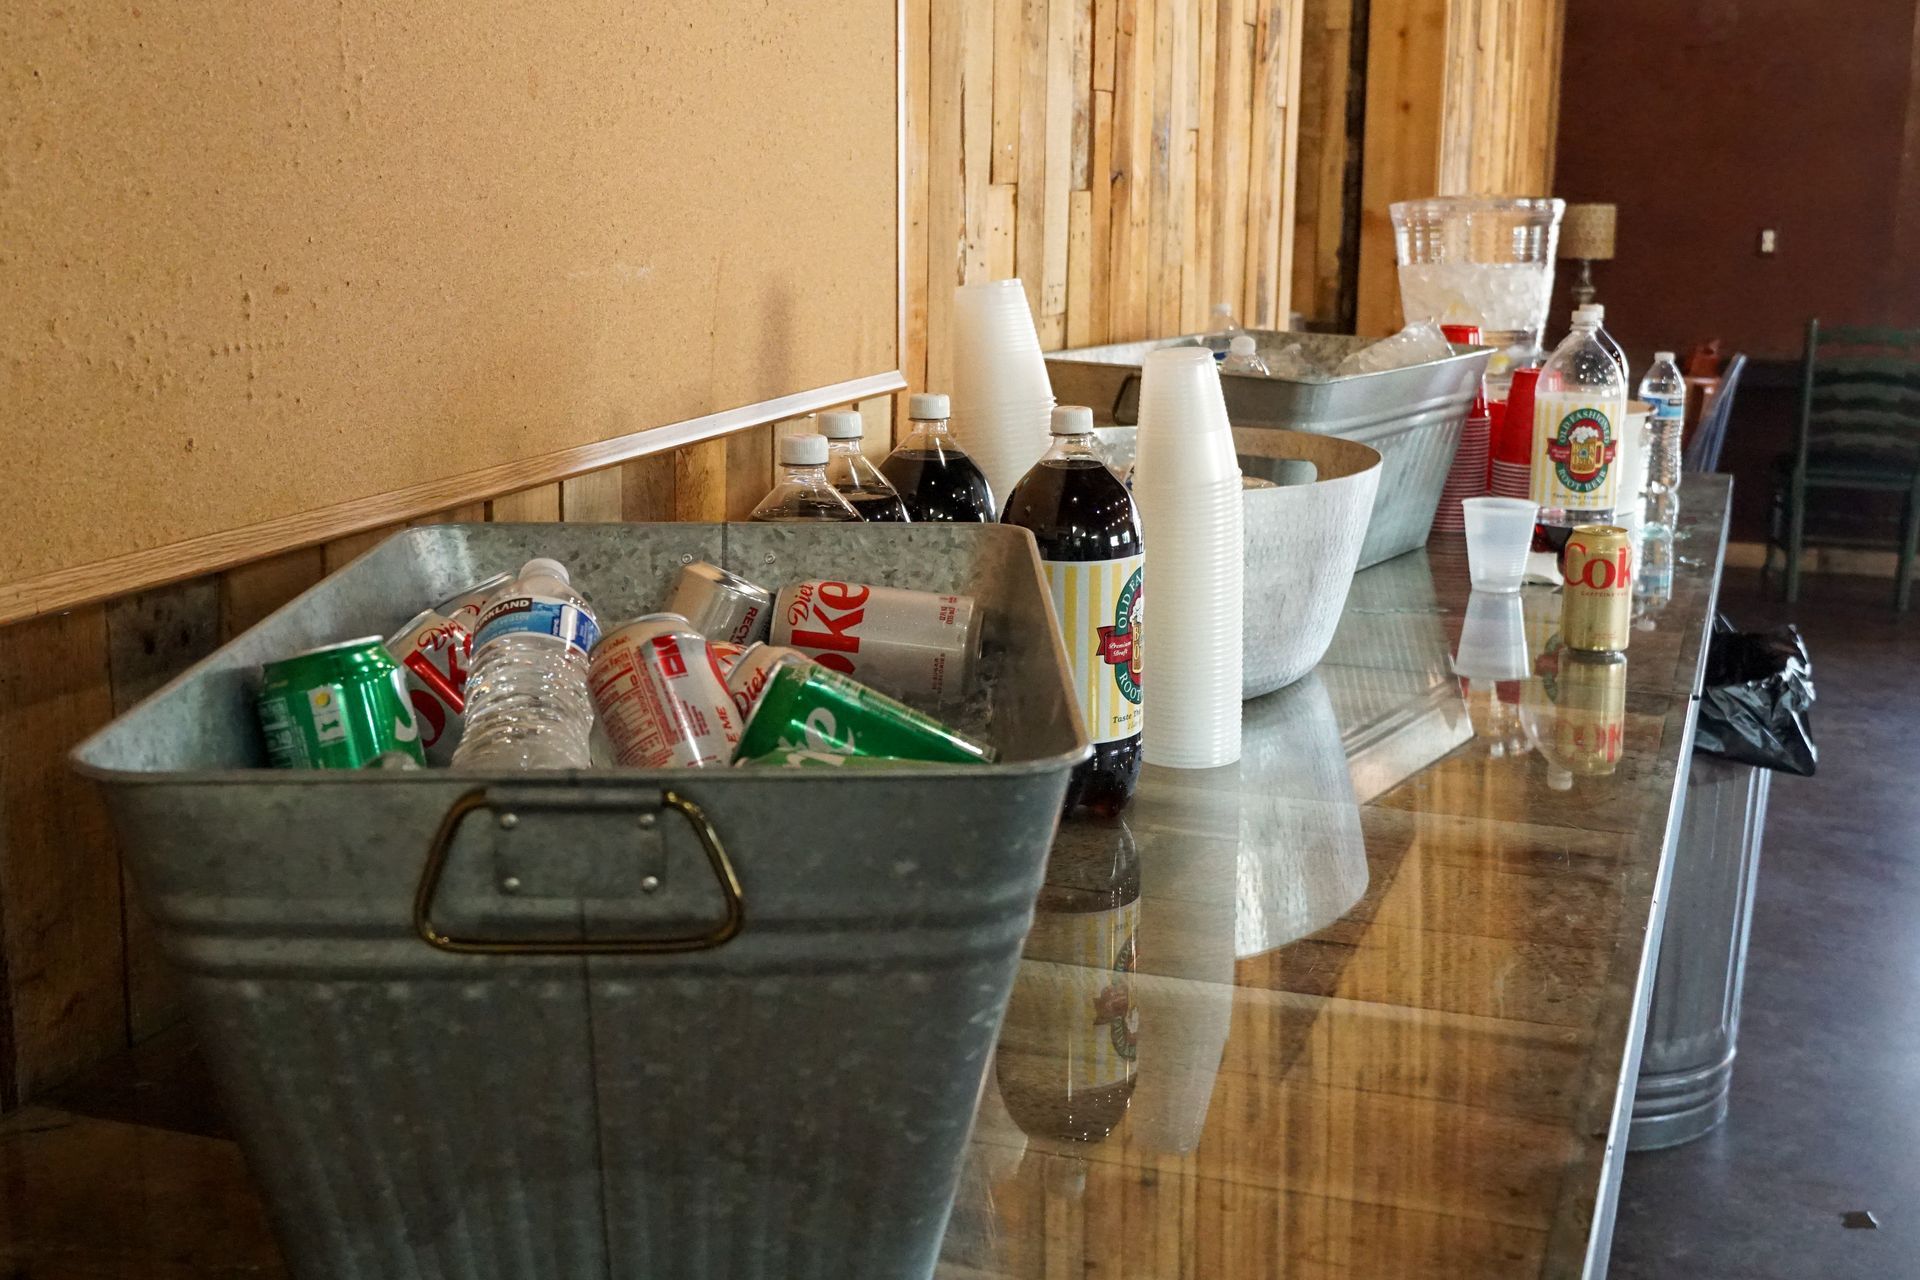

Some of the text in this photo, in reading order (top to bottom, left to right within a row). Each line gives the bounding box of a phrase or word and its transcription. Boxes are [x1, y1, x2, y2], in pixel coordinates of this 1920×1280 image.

[1559, 410, 1611, 444] OLD FASHIONED
[1558, 468, 1607, 491] ROOT BEER
[788, 583, 815, 626] Diet
[1118, 594, 1131, 629] OLD
[417, 618, 465, 652] Diet
[733, 666, 768, 725] Diet
[1119, 673, 1142, 702] ROOT
[1112, 712, 1132, 725] Taste
